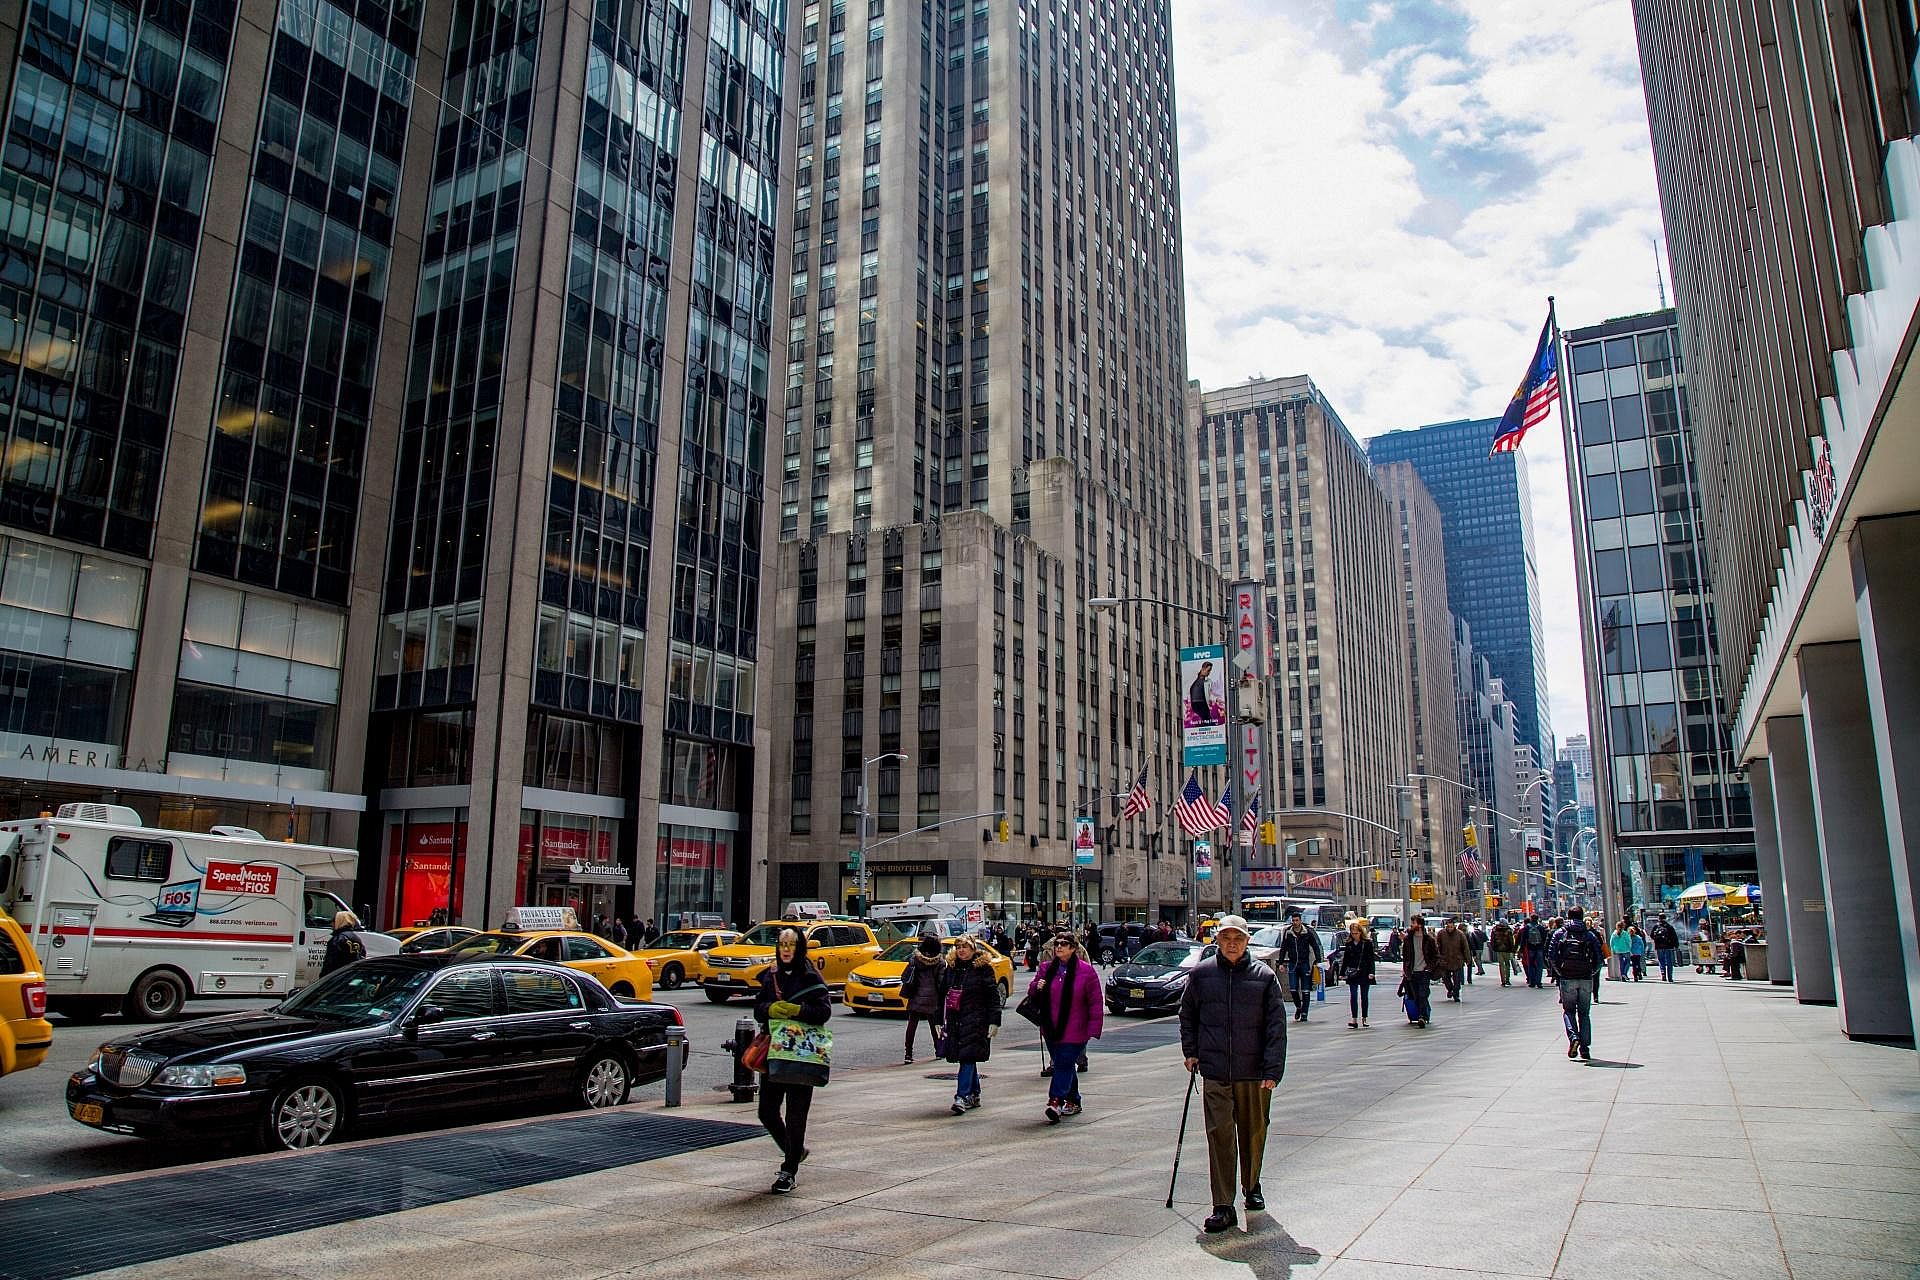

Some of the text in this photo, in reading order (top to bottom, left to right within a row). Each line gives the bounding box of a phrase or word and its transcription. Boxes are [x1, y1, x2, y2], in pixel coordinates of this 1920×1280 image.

[1238, 593, 1256, 680] RAD
[1243, 727, 1260, 786] ITY
[544, 839, 580, 849] Santander
[672, 849, 701, 859] Santander
[413, 861, 452, 871] Santande
[584, 862, 630, 876] Santander
[887, 864, 932, 874] BROTHERS
[245, 882, 270, 893] FiOS
[164, 890, 192, 905] FiOS
[520, 909, 561, 918] PRIVATE EYES
